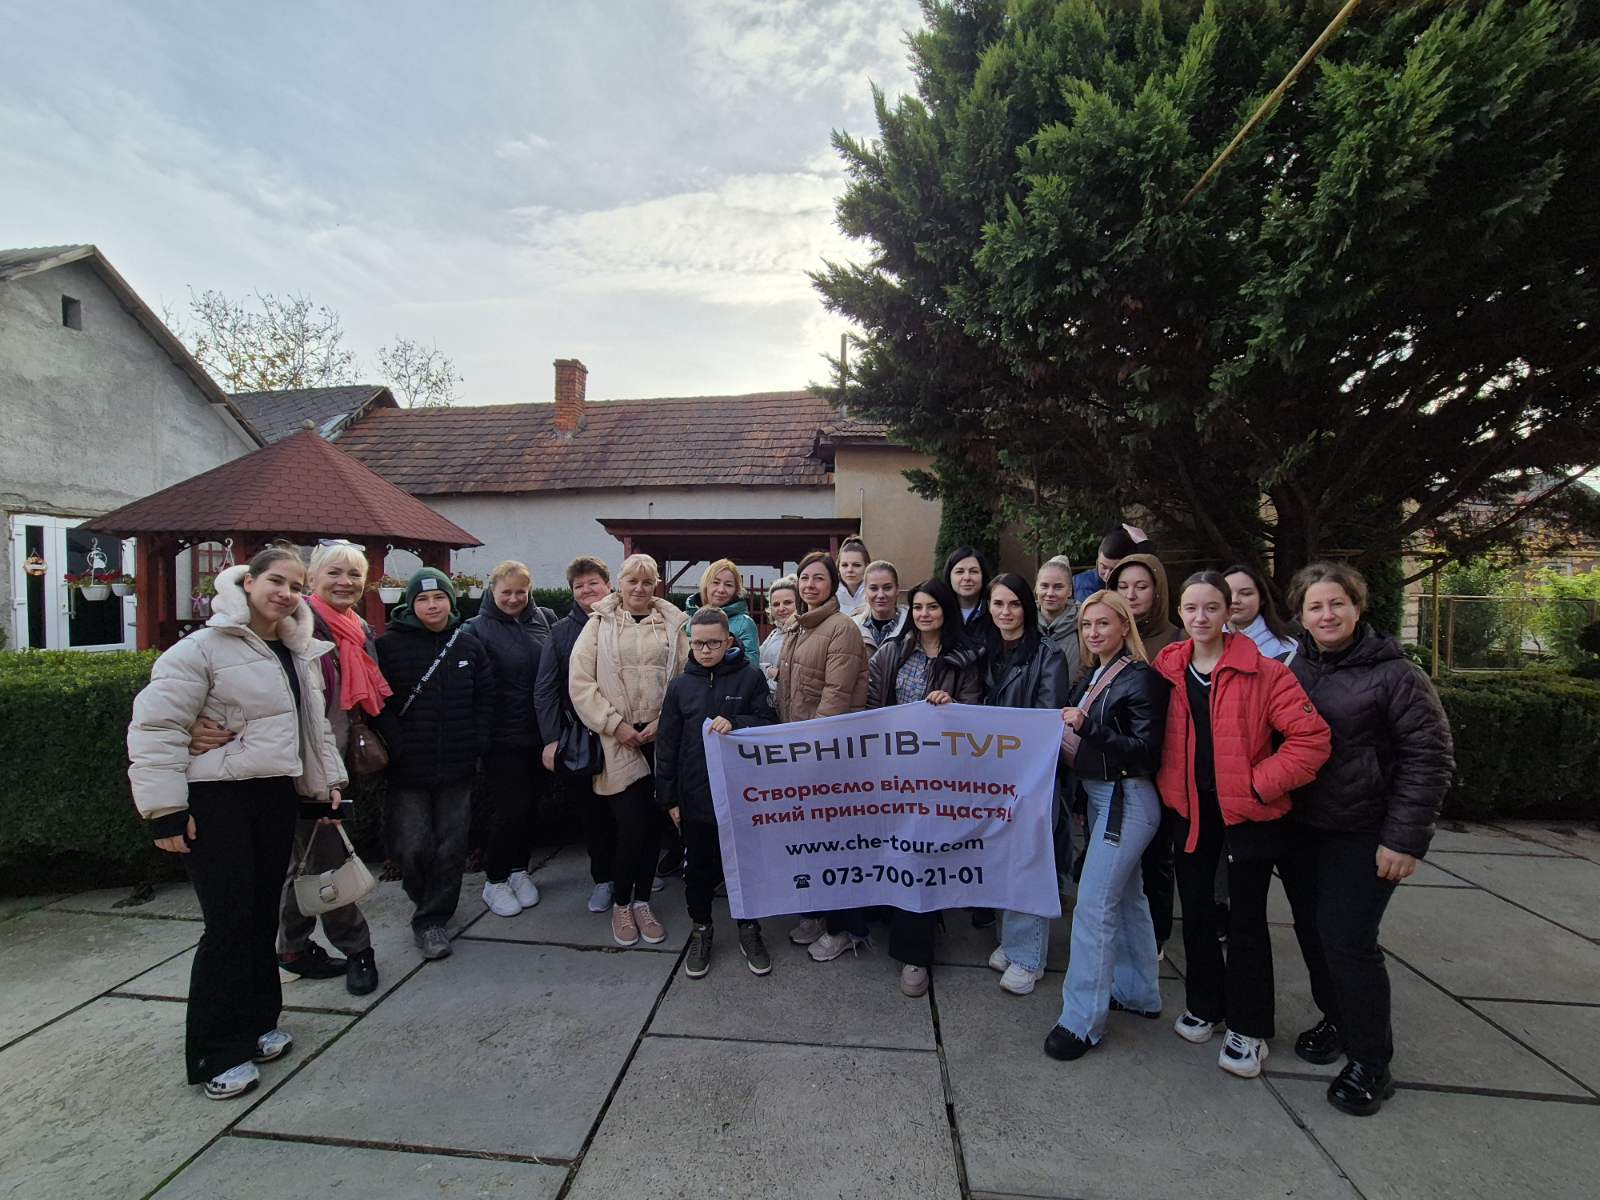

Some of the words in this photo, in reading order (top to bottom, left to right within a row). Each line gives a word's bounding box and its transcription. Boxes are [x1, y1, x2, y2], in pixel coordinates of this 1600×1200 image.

[737, 730, 1022, 766] ЧЕРНІГІВ-ТУР
[742, 780, 875, 803] Створюємо
[880, 775, 1018, 801] відпочинок,
[751, 805, 804, 827] який
[810, 801, 930, 823] приносить
[935, 803, 1013, 823] щастя!
[785, 833, 984, 856] www.che-tour.com
[821, 865, 984, 888] 073-700-21-01
